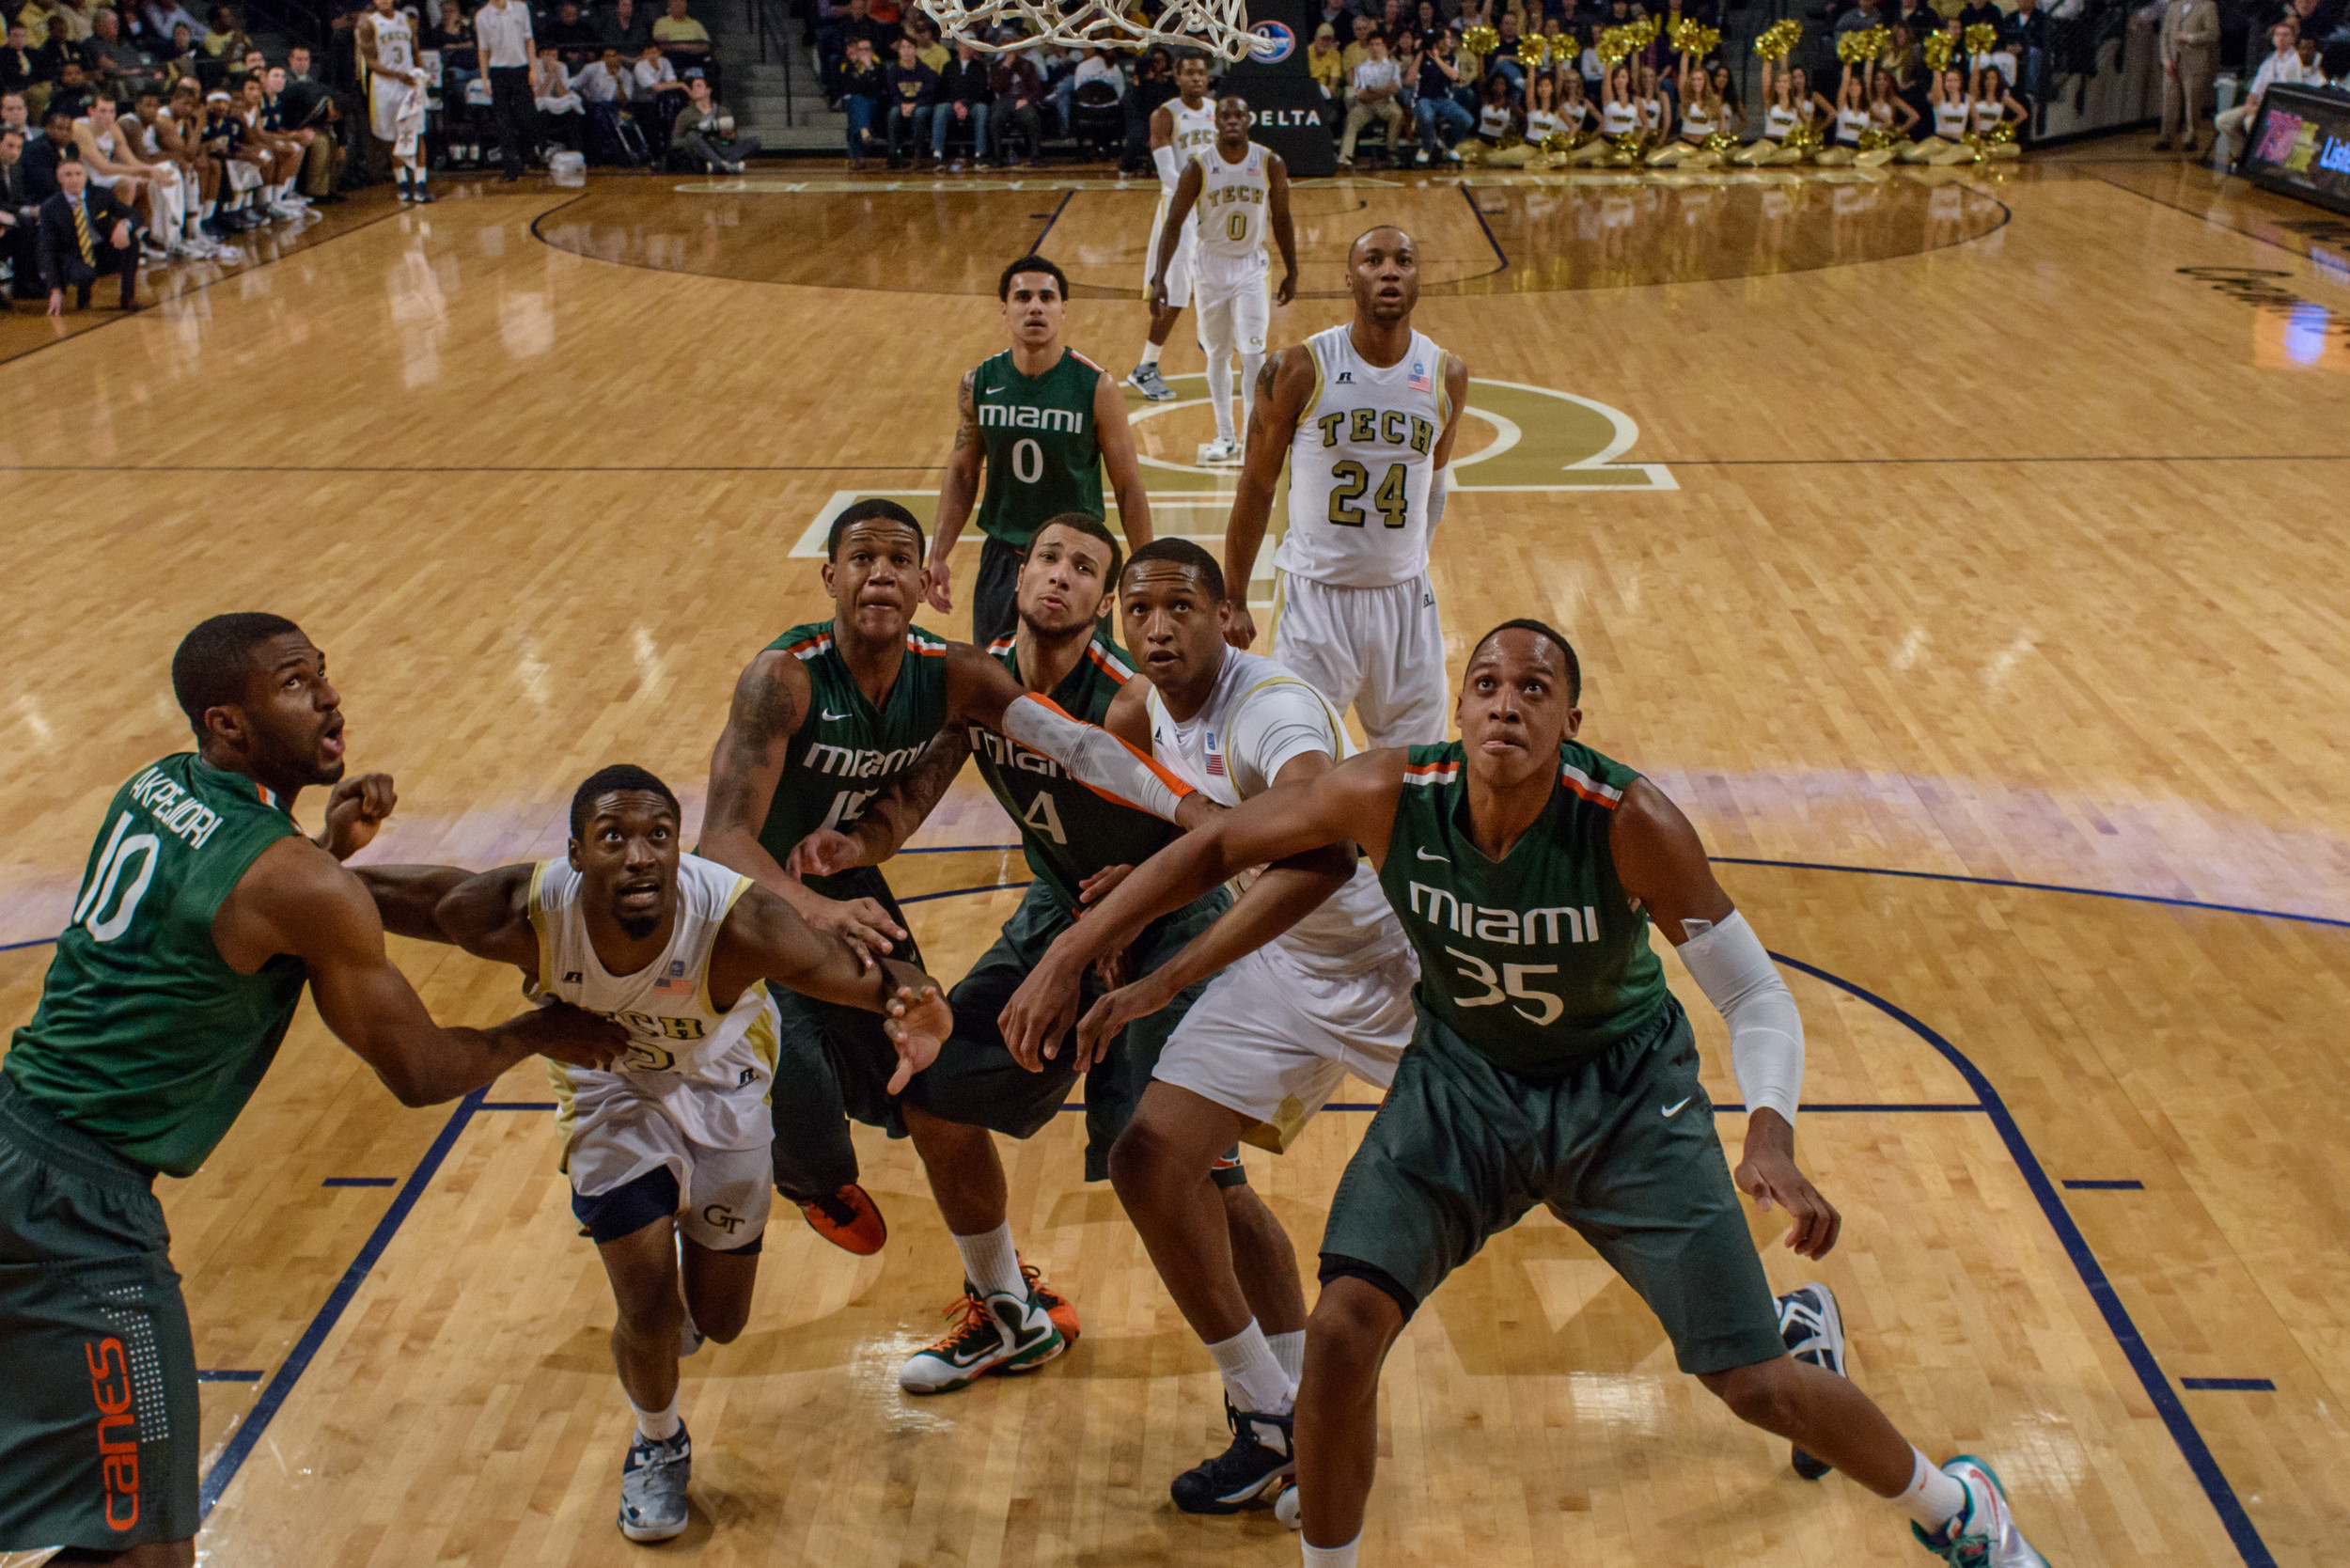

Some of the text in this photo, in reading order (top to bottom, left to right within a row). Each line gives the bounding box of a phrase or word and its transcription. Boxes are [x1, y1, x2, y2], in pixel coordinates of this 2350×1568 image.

[392, 46, 403, 64] 3
[1248, 110, 1321, 126] DELTA
[1209, 185, 1264, 207] TECH
[1227, 211, 1246, 242] 0
[1318, 408, 1434, 457] TECH
[1012, 438, 1043, 483] 0
[1328, 459, 1407, 528] 24
[969, 726, 1073, 781] mia
[1024, 790, 1068, 845] 4
[73, 809, 161, 942] 10
[1445, 945, 1564, 1027] 35
[703, 1203, 745, 1234] GT
